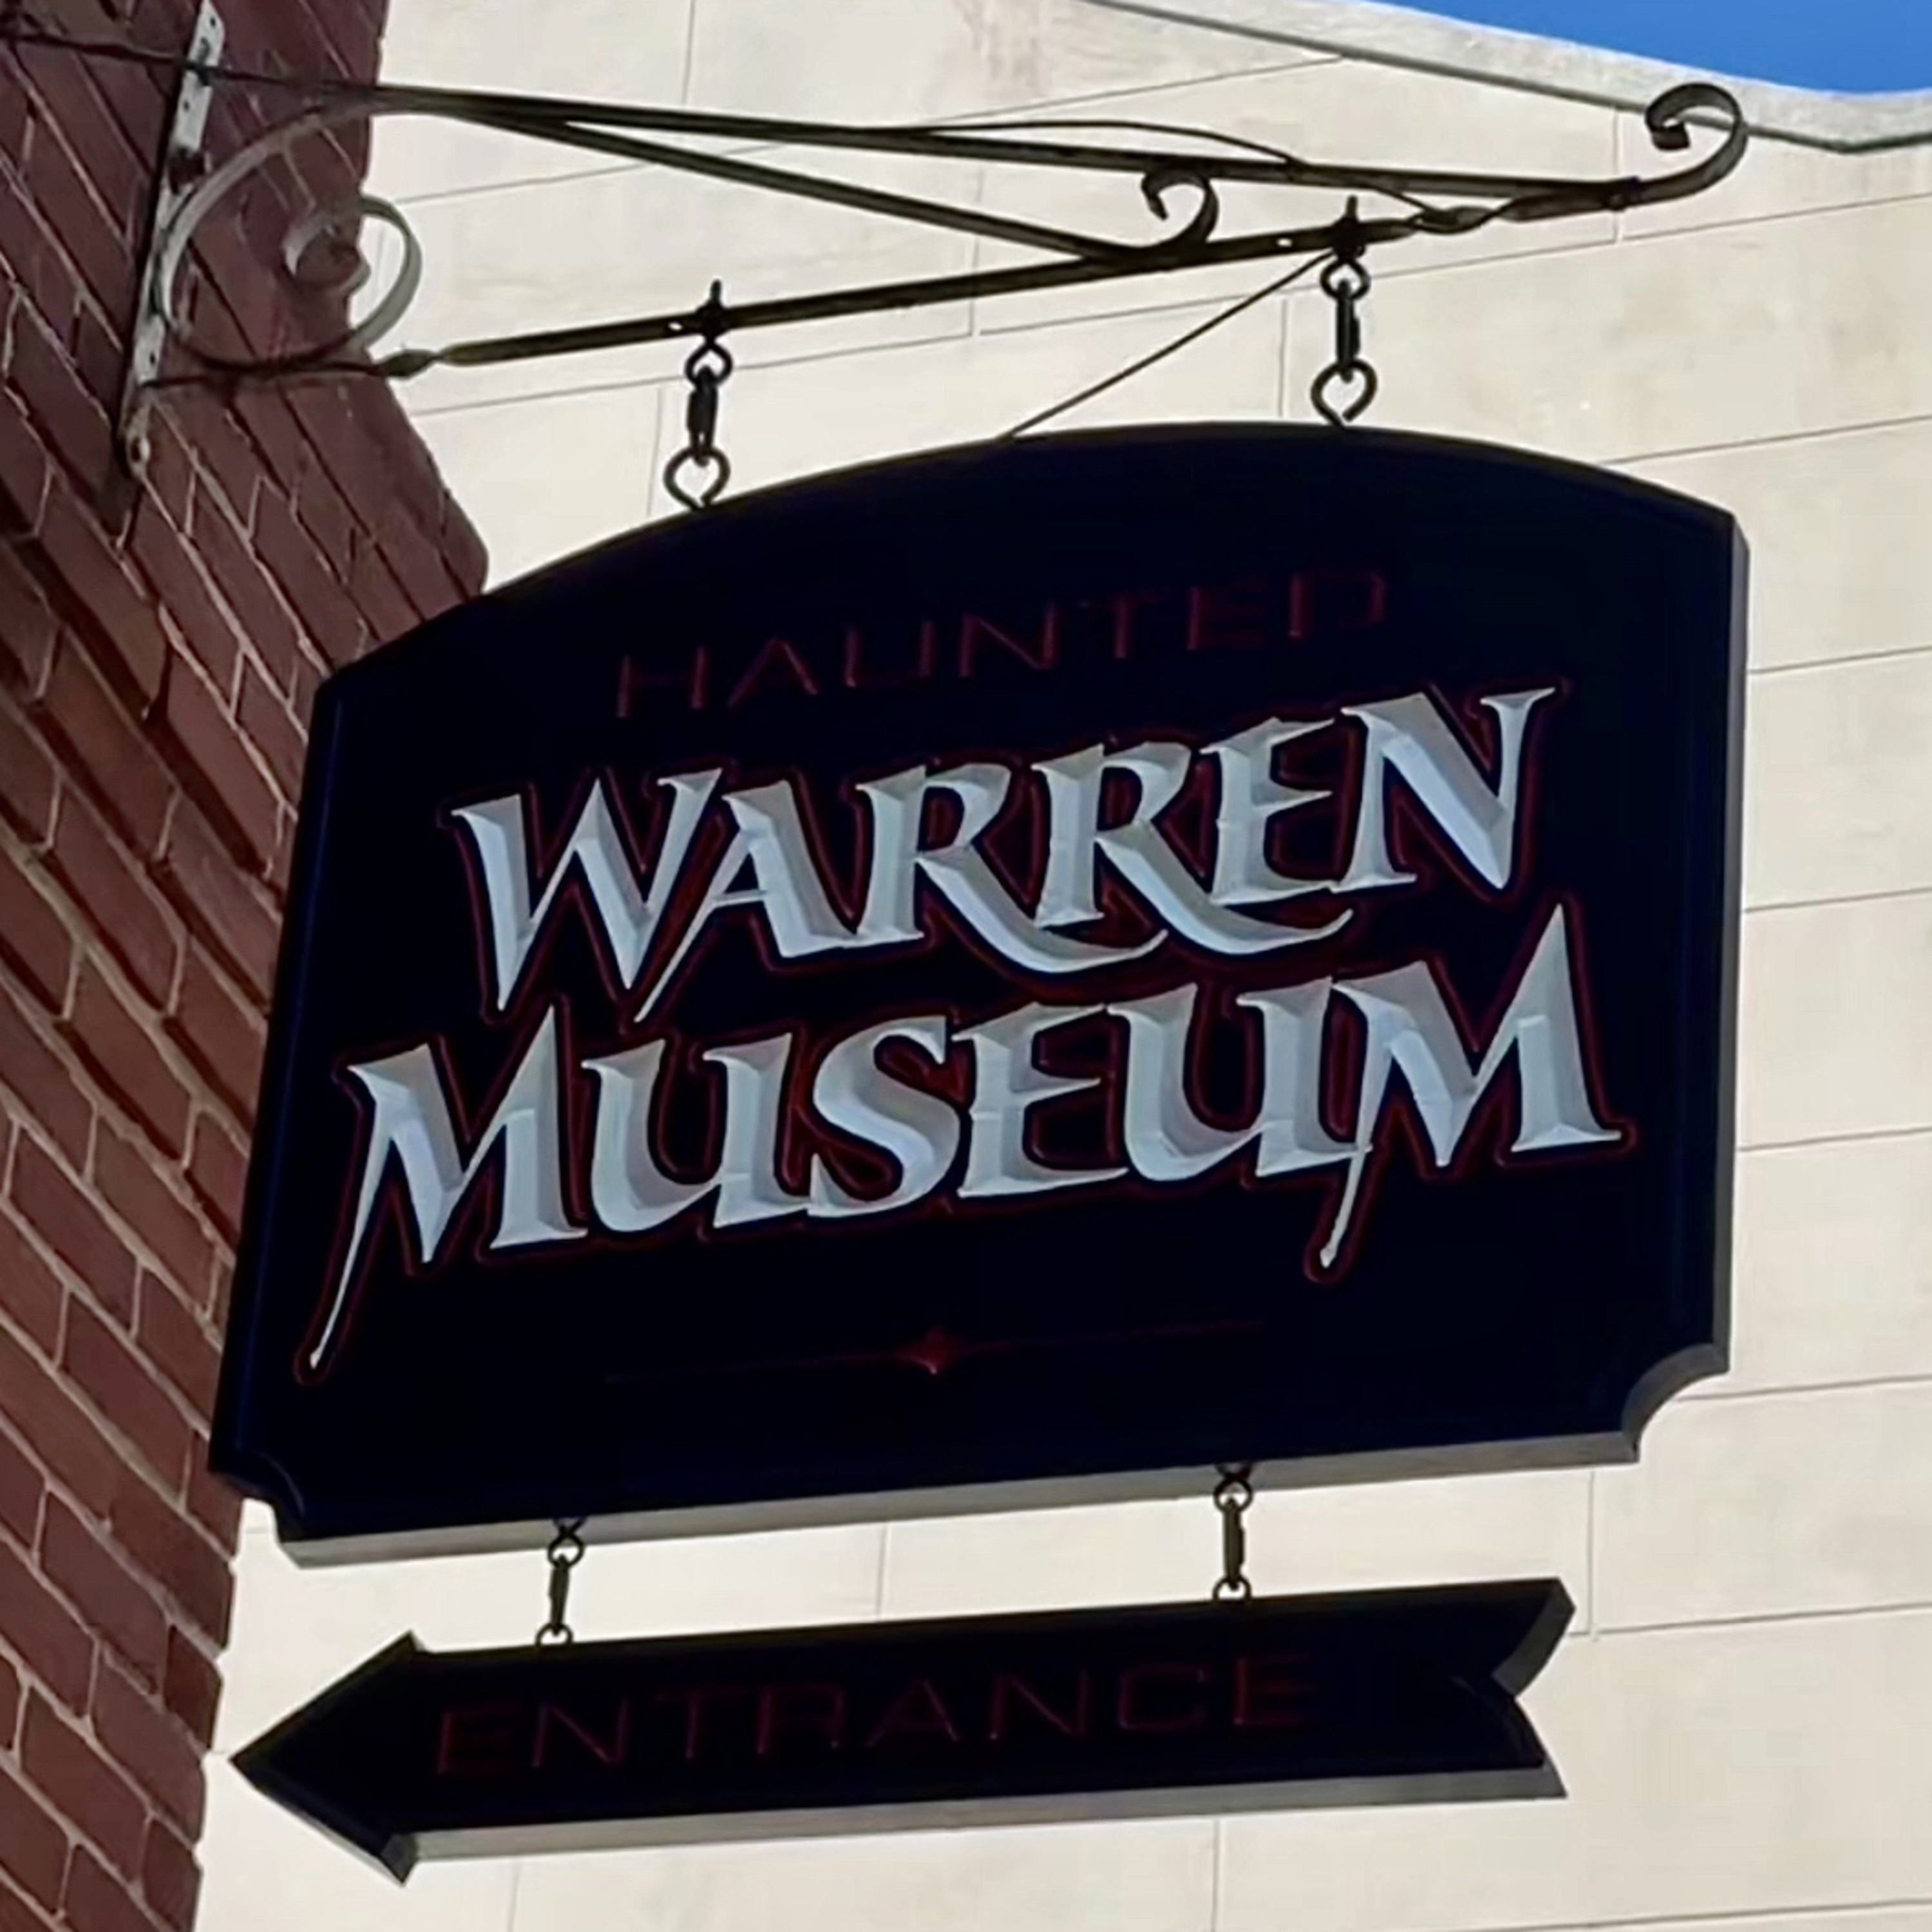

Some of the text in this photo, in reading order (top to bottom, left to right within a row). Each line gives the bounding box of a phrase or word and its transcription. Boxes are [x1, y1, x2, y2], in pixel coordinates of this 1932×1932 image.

[614, 568, 1388, 719] HAUNTED
[450, 686, 1558, 1023] WARREN
[308, 903, 1624, 1370] MUSEUM
[435, 1654, 1309, 1777] ENTRANCE
